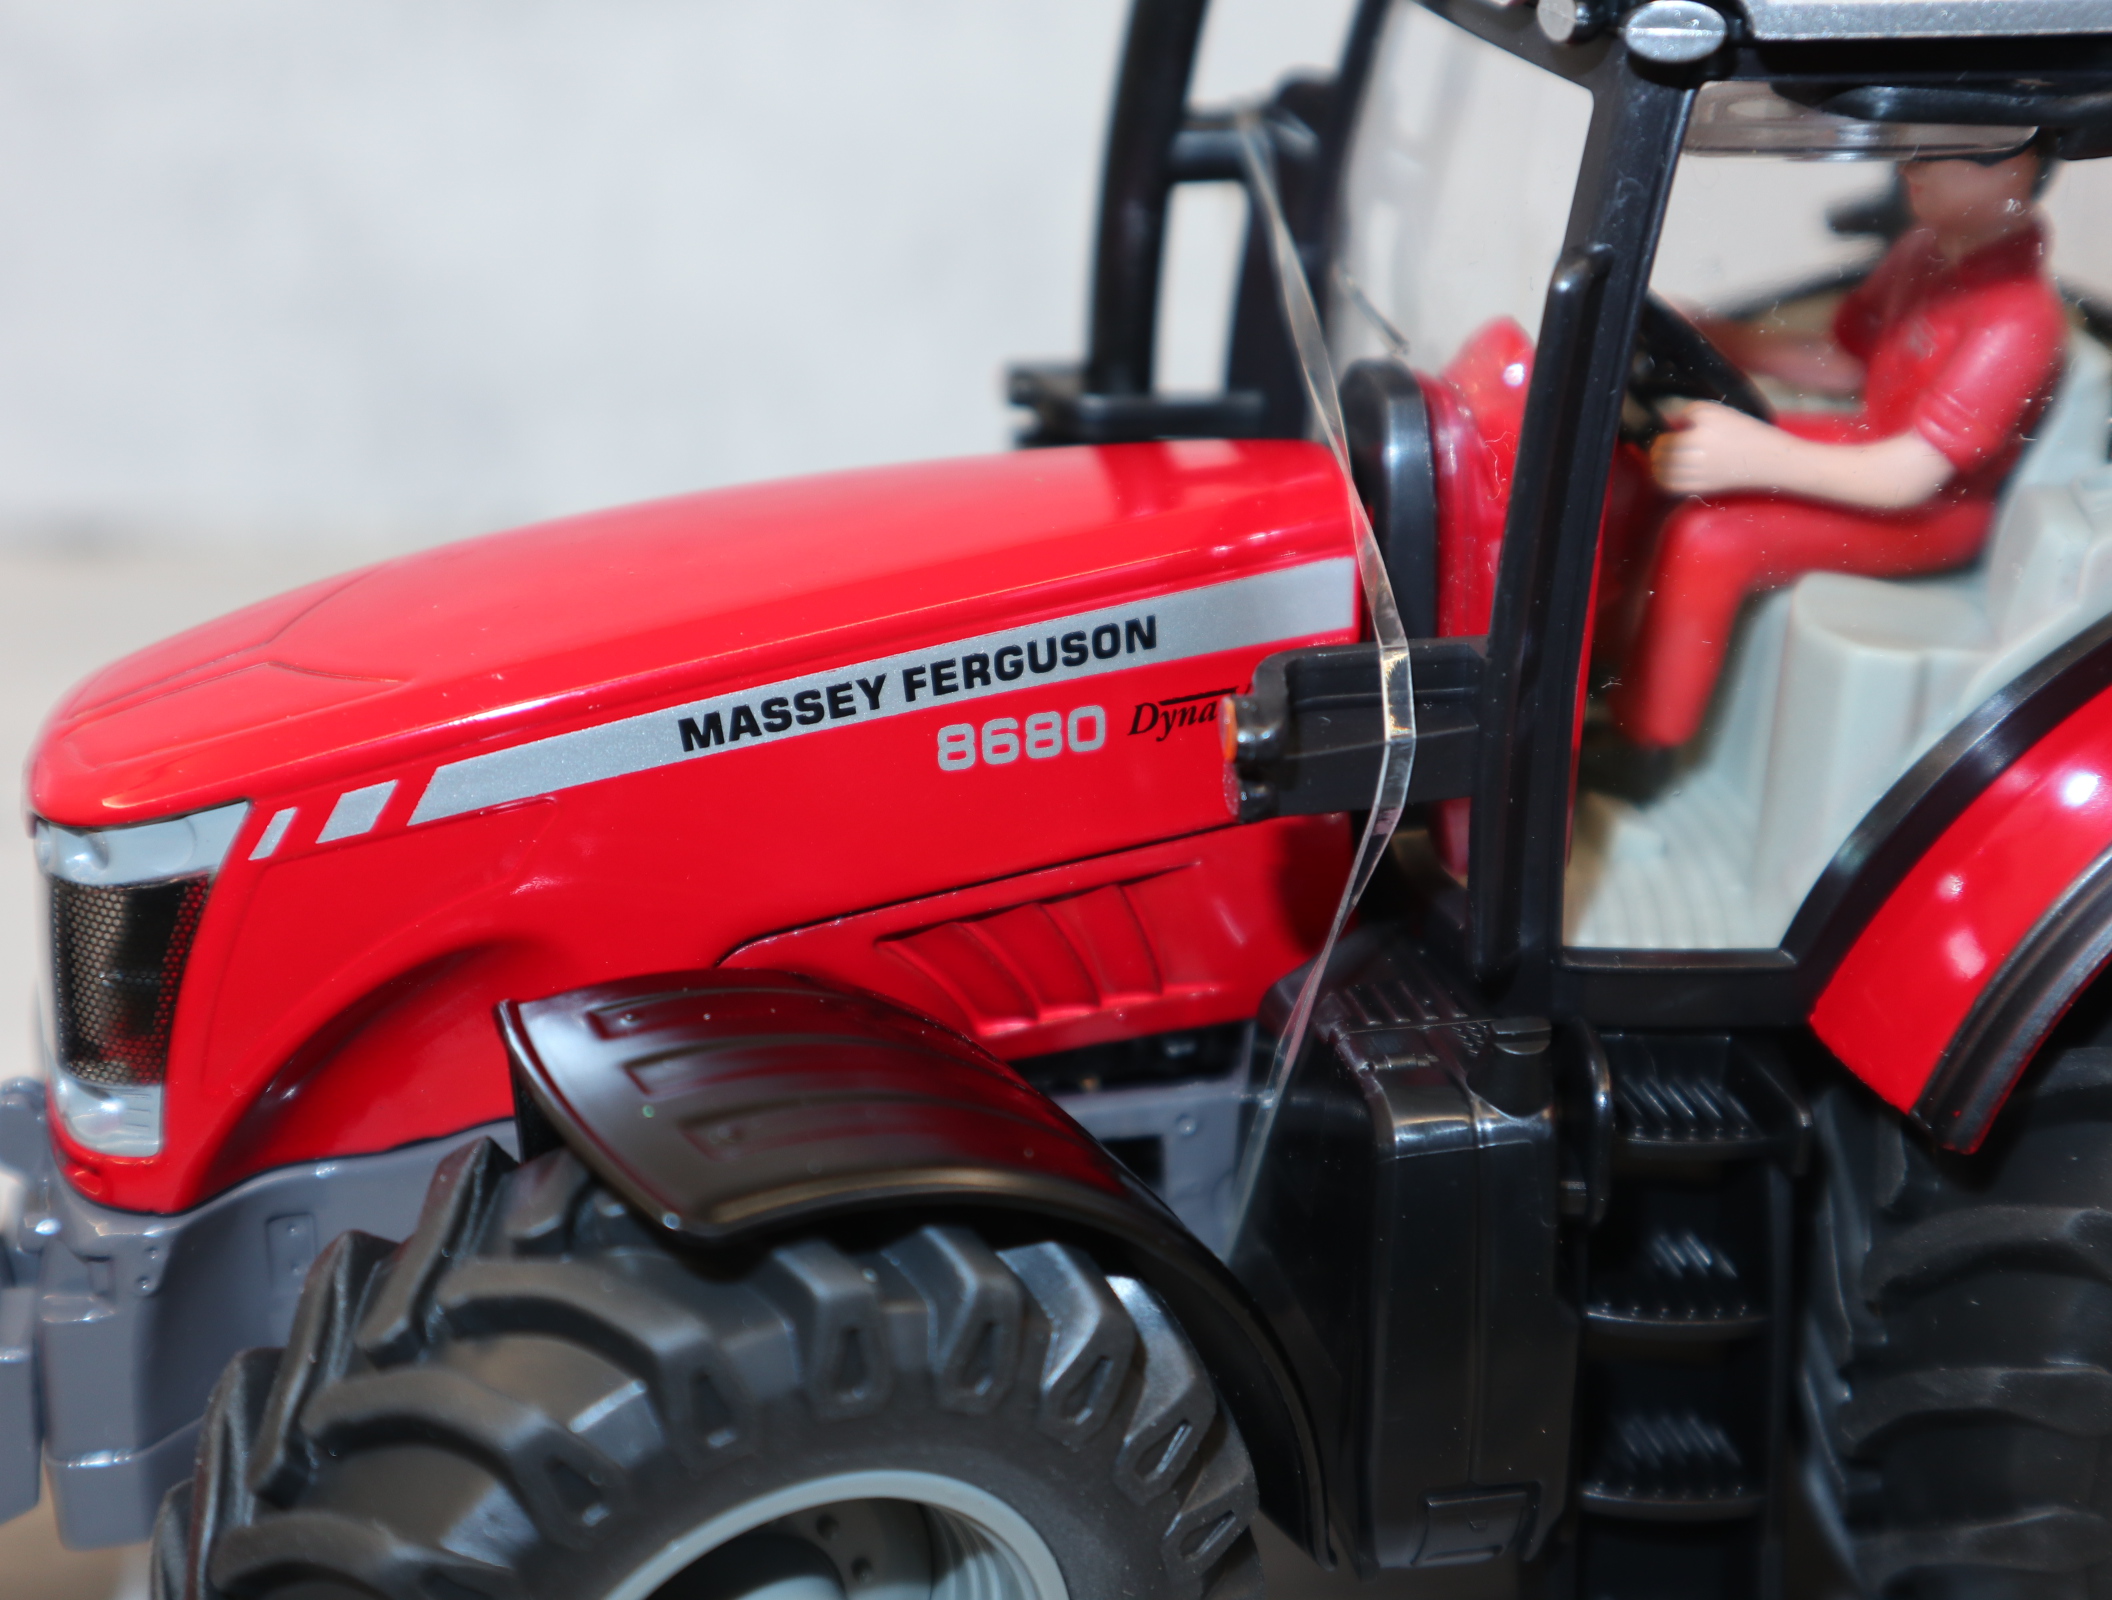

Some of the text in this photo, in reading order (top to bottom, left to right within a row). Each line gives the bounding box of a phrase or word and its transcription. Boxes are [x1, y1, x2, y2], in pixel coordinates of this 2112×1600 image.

[677, 614, 1157, 752] MASSEY FERGUSON
[937, 688, 1237, 772] 8680 Dyna
